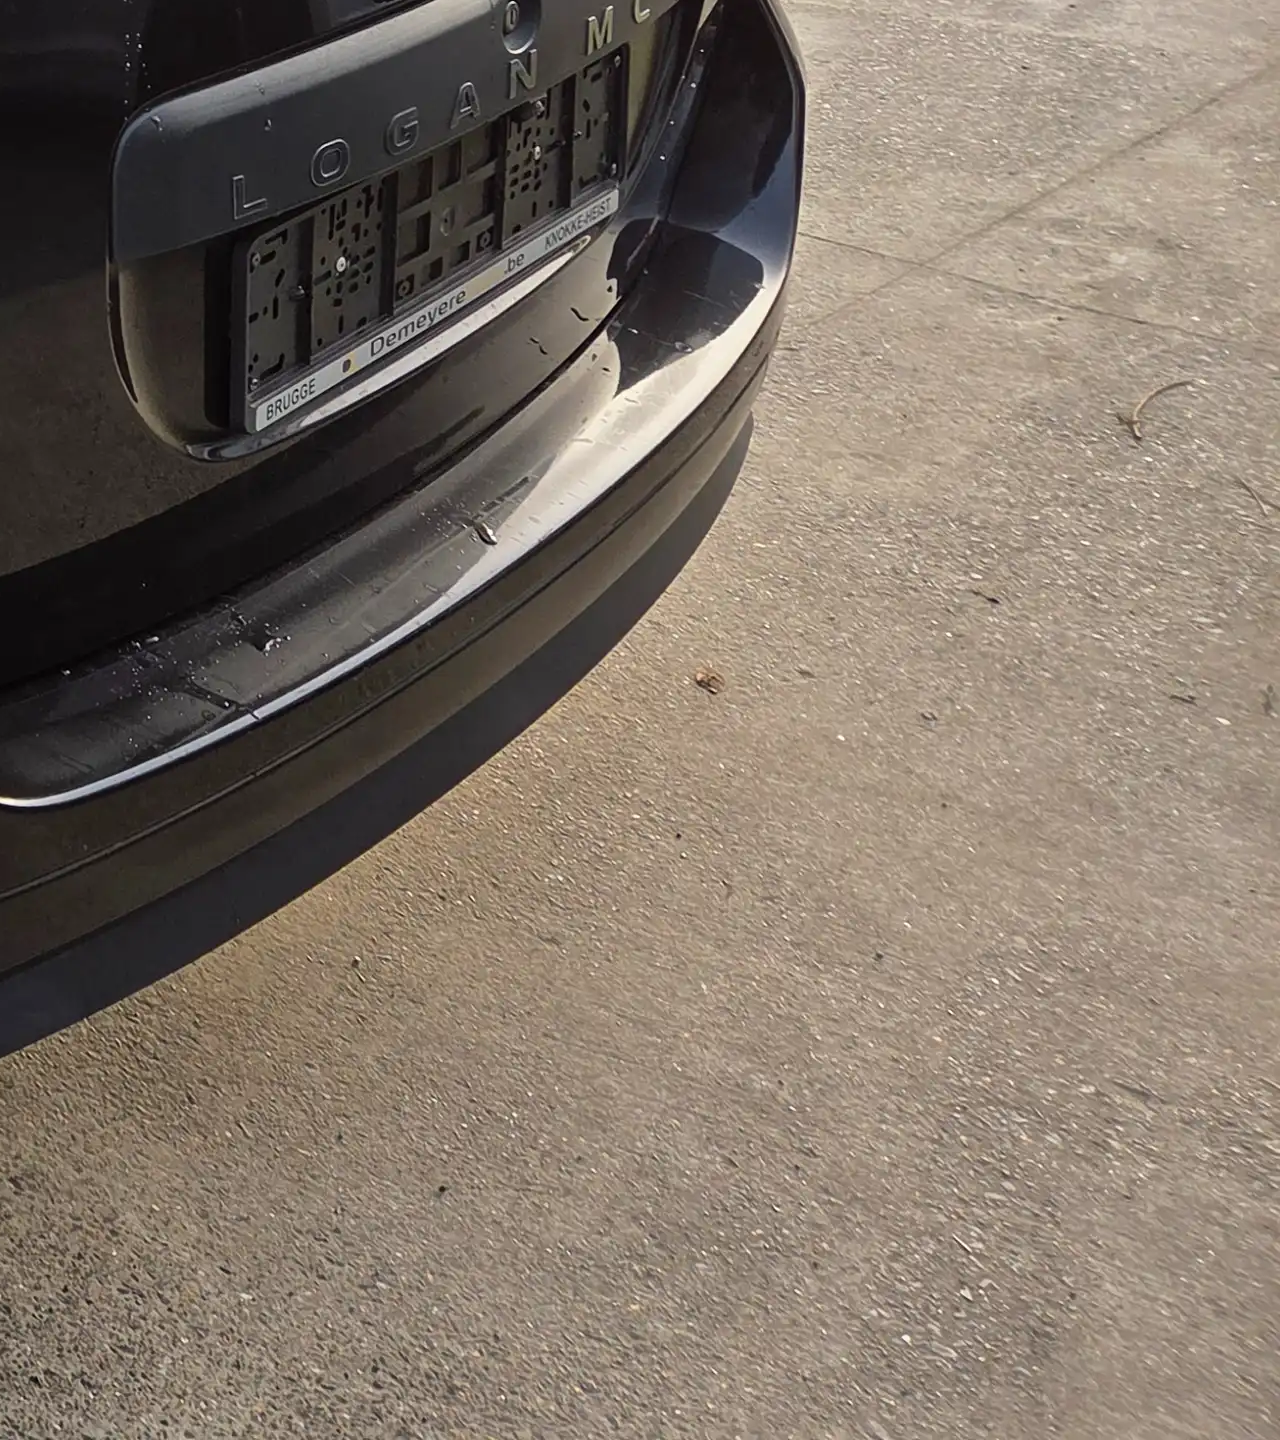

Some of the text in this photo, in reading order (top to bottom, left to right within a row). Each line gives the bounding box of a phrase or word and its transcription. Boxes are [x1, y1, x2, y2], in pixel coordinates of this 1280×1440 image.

[232, 49, 538, 220] LOGAN
[266, 197, 612, 421] BRUGGE Demeyere .be KNOKKE-HEIST
